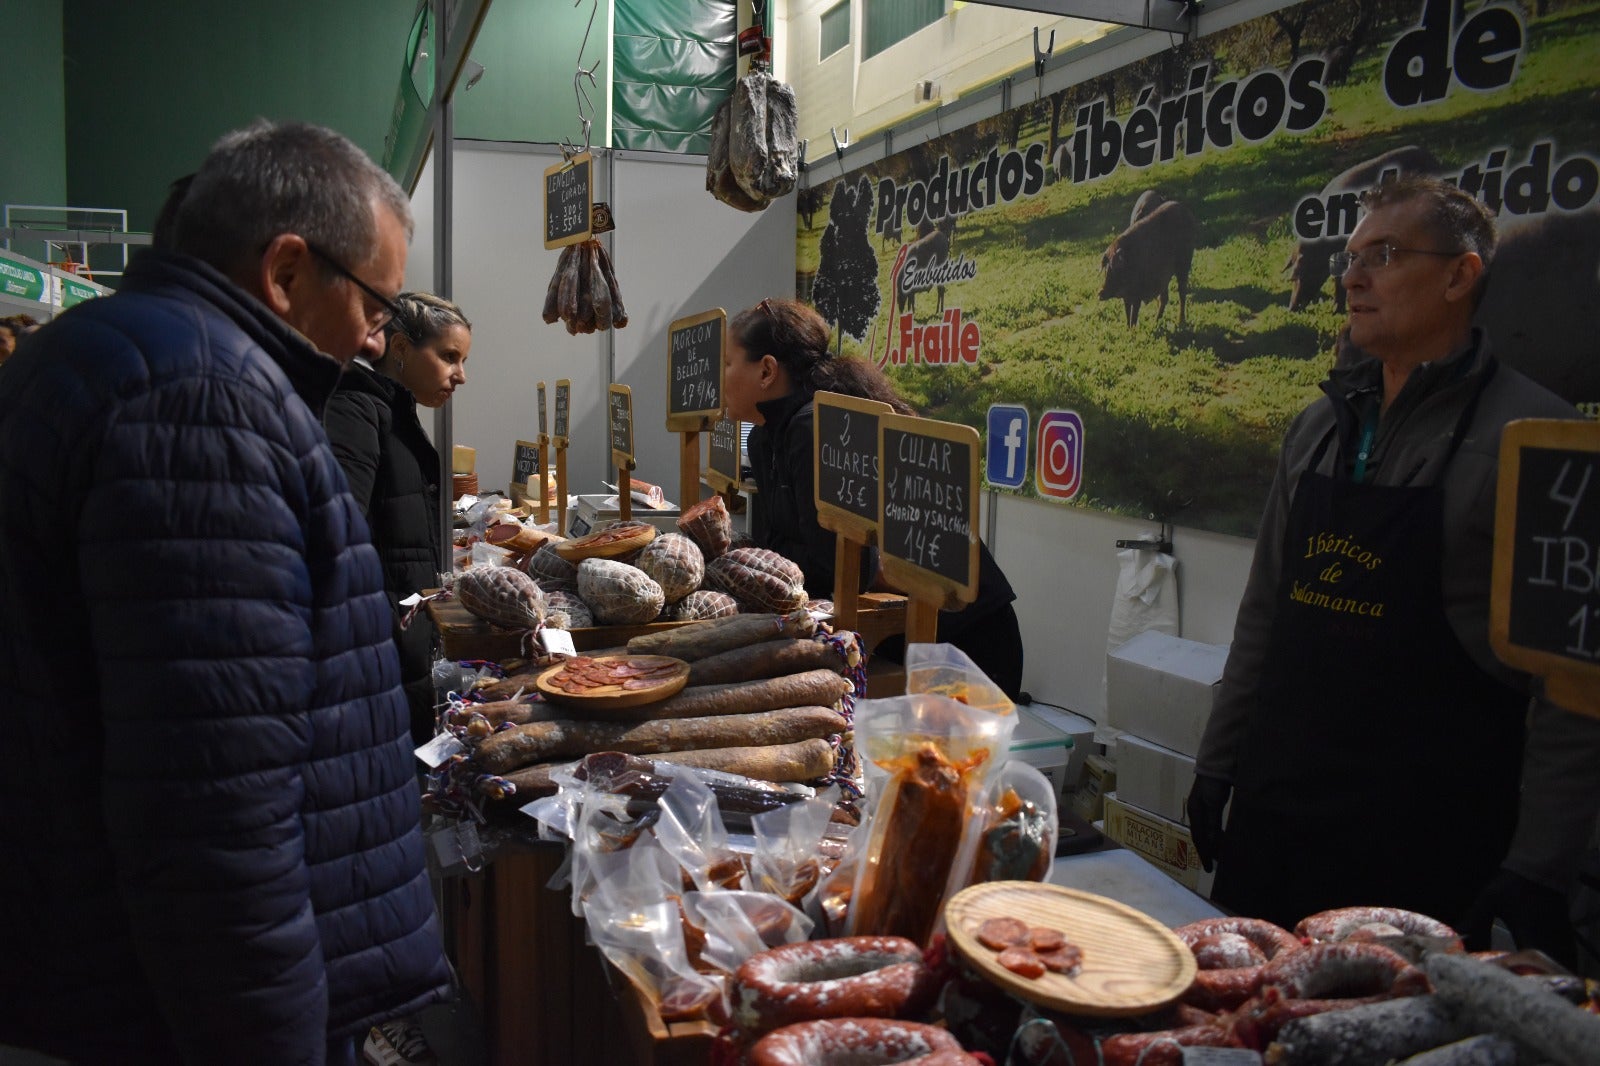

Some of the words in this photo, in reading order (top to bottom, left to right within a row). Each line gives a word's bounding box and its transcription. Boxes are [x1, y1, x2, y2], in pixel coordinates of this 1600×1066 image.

[875, 143, 1045, 234] Productos
[1072, 59, 1327, 184] ibéricos
[1384, 0, 1523, 106] de
[901, 254, 977, 292] Embutidos
[676, 357, 710, 382] BELLOTA
[687, 347, 697, 362] DE
[821, 443, 879, 481] CULARES
[899, 432, 951, 474] CULAR
[903, 475, 963, 512] MITADES
[1549, 458, 1593, 532] 4
[1304, 531, 1382, 570] Ibéricos
[1320, 561, 1343, 584] de
[1289, 580, 1384, 617] Salamanca
[1126, 820, 1164, 842] PALACIOS
